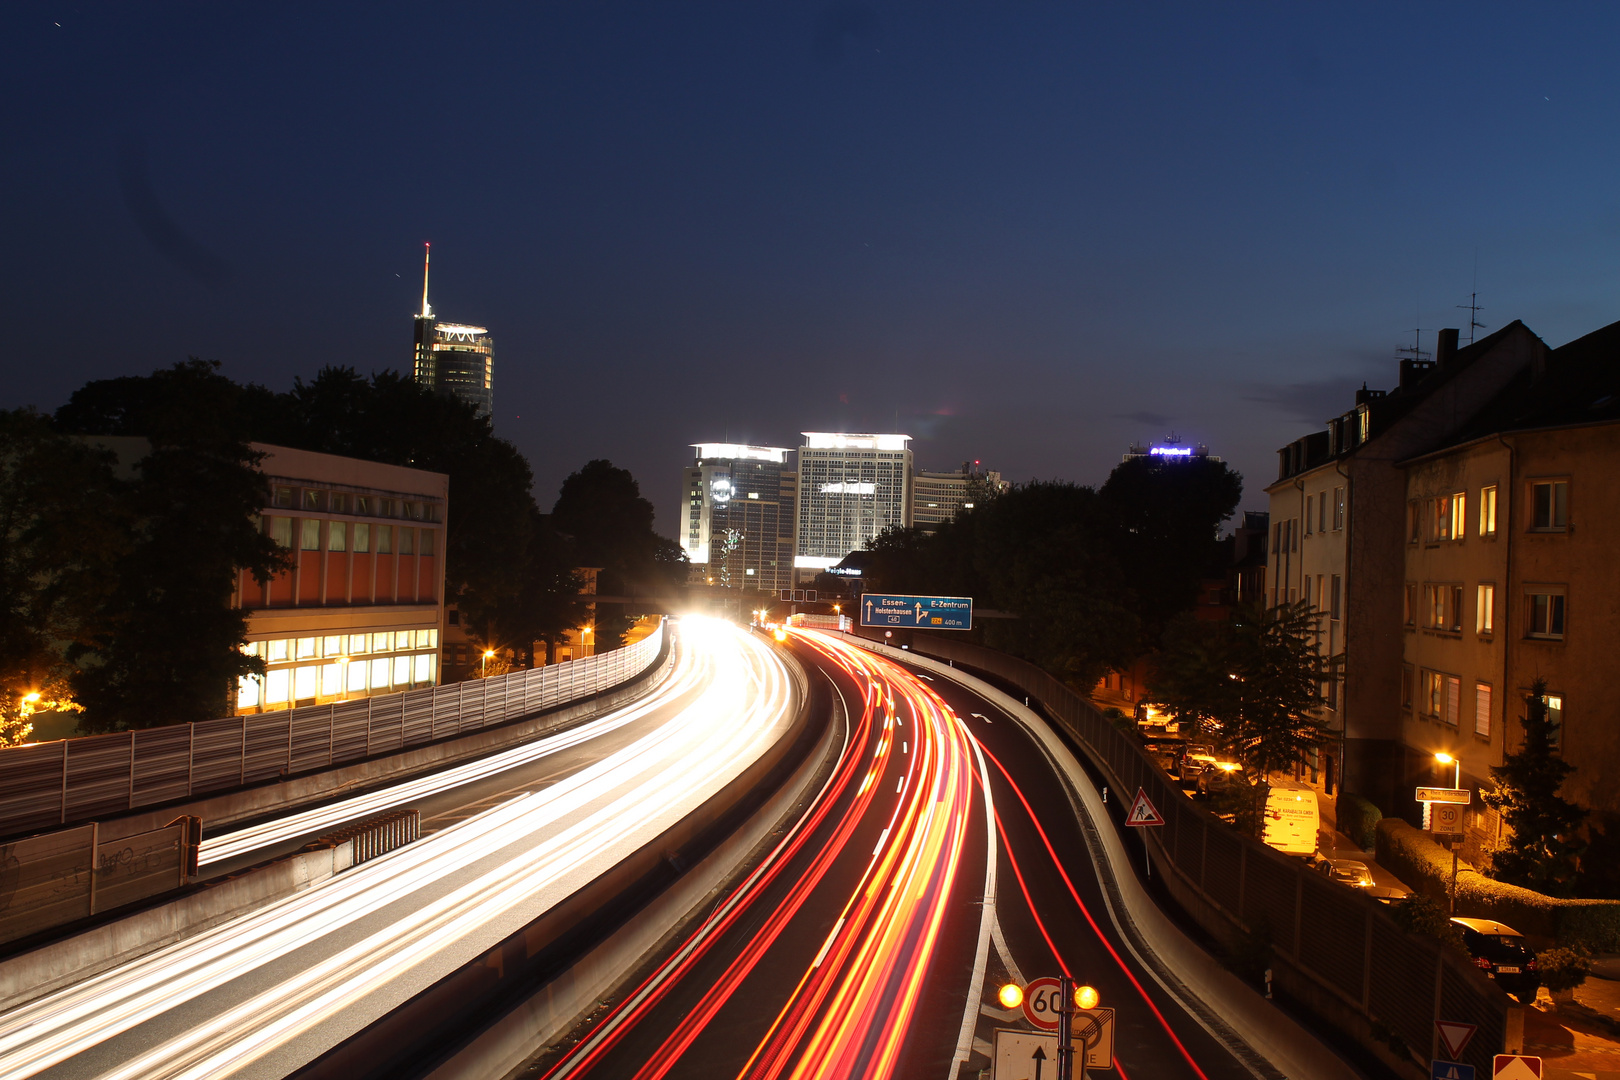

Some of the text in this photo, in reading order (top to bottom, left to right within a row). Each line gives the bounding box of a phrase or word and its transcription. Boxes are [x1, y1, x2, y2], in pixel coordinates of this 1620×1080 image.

[882, 598, 907, 607] Essen-
[931, 600, 969, 609] E-Zentrum
[875, 607, 912, 615] Holsterhausen
[1442, 810, 1455, 821] 30
[1033, 989, 1061, 1014] 60
